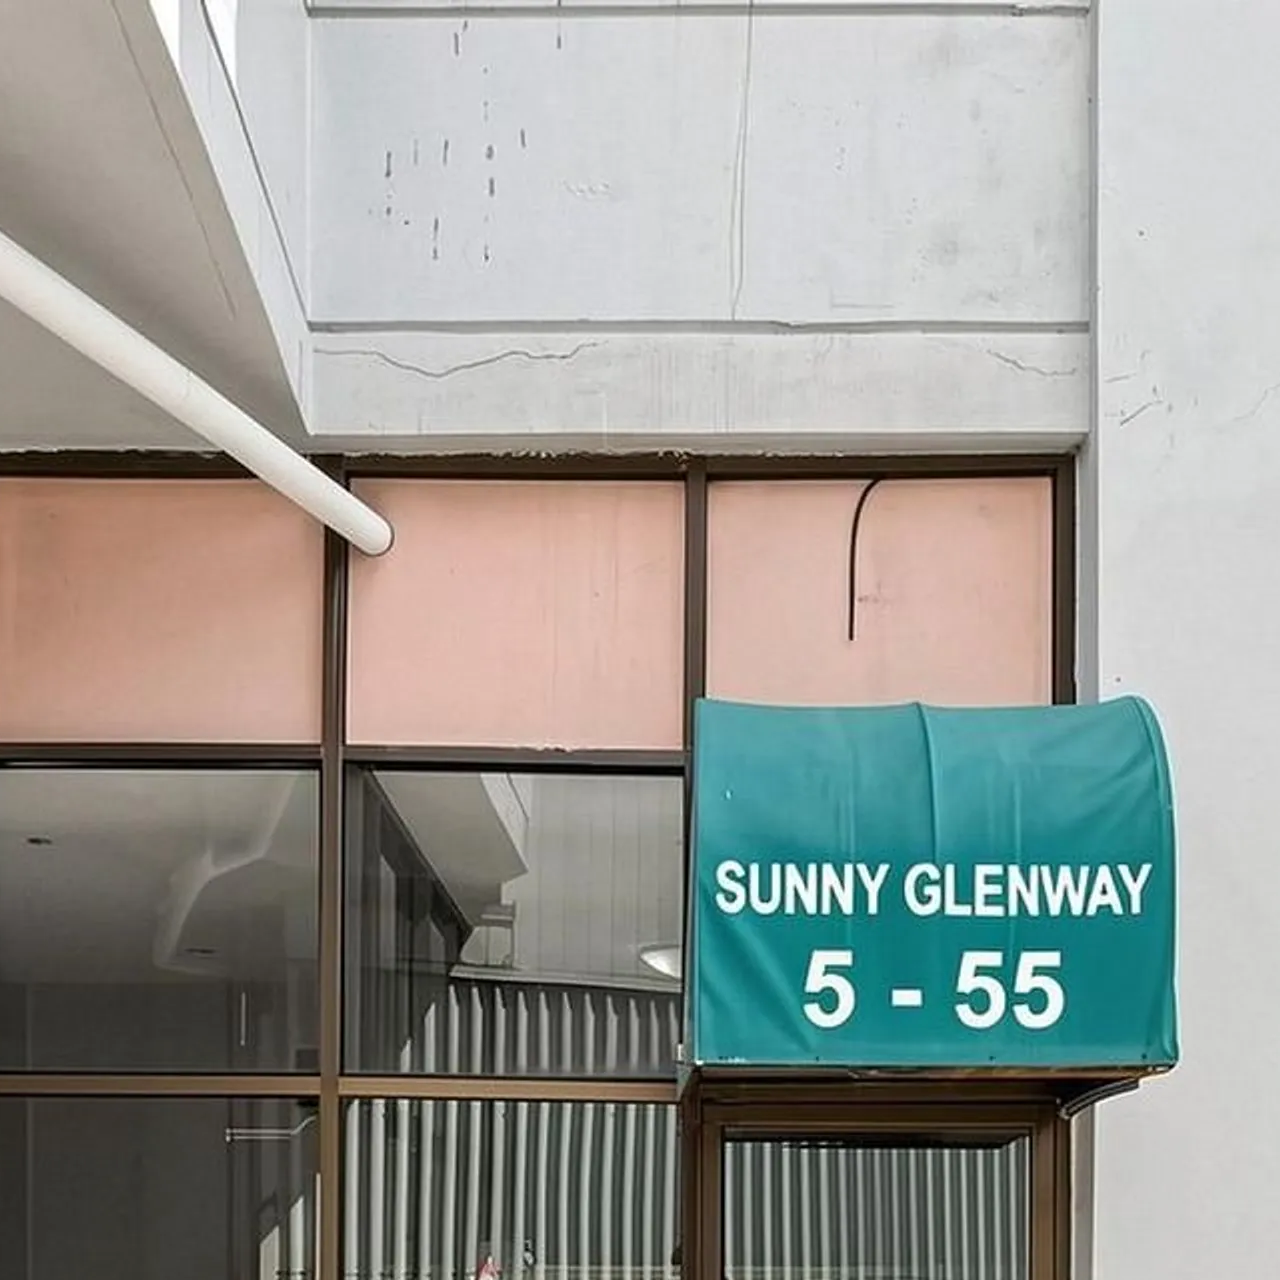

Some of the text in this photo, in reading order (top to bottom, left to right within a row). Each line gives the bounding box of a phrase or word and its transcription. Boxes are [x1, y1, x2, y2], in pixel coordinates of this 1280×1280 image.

[716, 860, 1152, 917] SUNNY GLENWAY
[803, 949, 1065, 1029] 5 - 55
